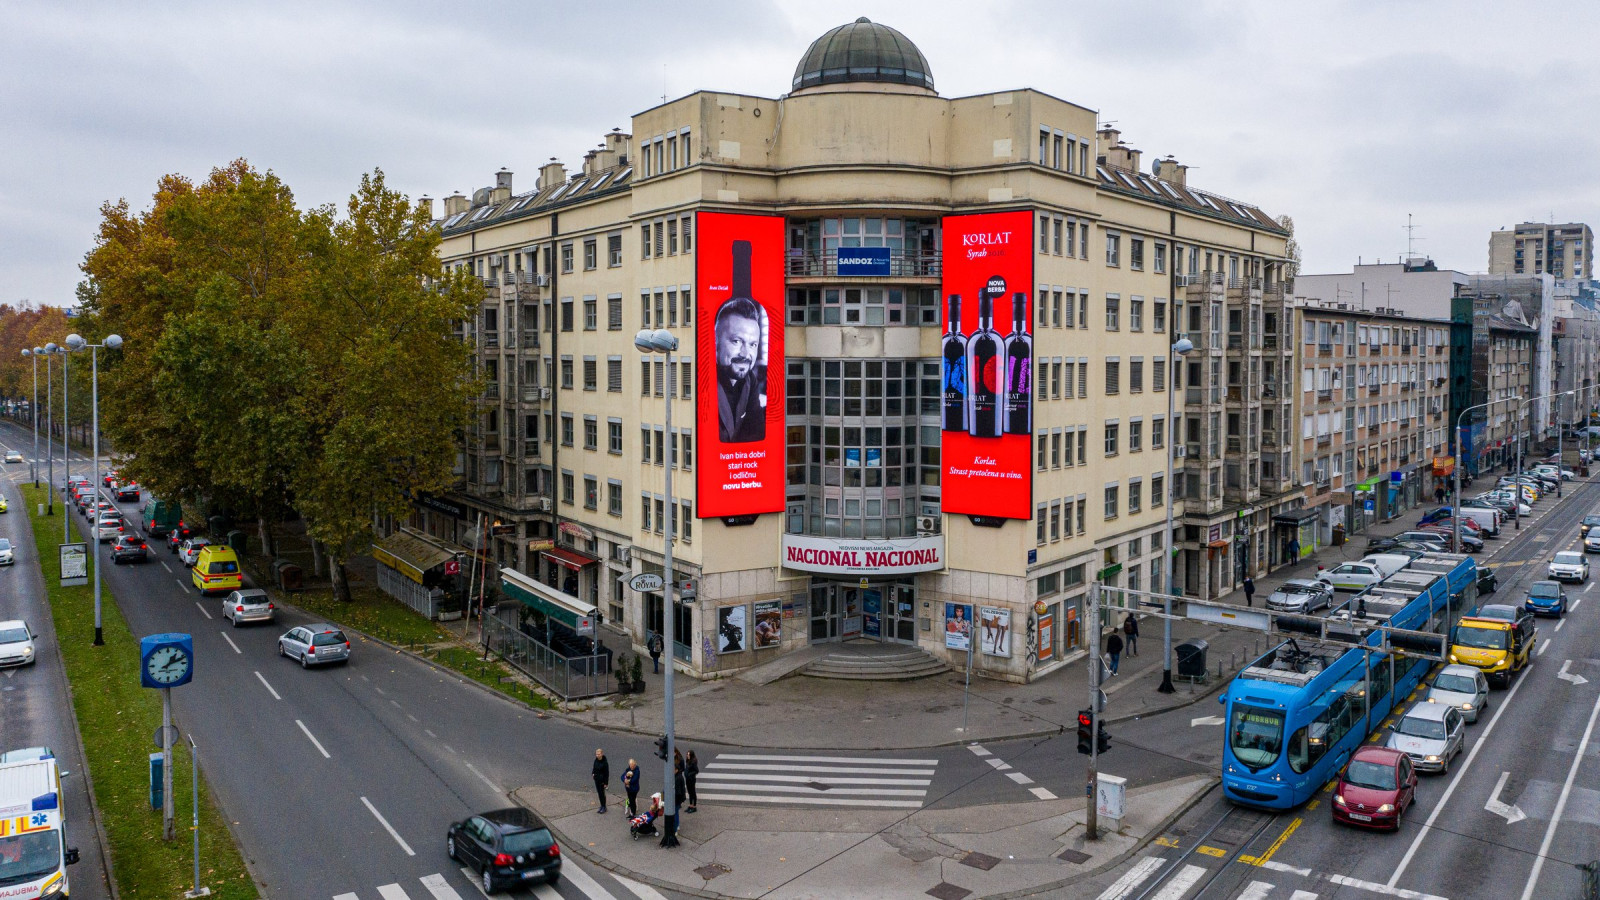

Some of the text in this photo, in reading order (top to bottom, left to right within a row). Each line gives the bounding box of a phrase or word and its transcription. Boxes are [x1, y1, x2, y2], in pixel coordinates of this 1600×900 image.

[962, 231, 1012, 246] KORLAT
[967, 247, 988, 260] Syrah
[838, 257, 873, 265] SANDOZ
[735, 451, 748, 459] bira
[749, 450, 766, 459] dobri
[728, 461, 758, 470] stari rock
[974, 456, 997, 466] Korlat.
[733, 471, 757, 480] odličnu
[949, 466, 970, 475] Strast
[968, 468, 999, 478] pretočena
[1006, 470, 1023, 479] vino.
[741, 480, 763, 489] berbu.
[787, 546, 939, 567] NACIONAL NACIONAL
[635, 581, 658, 590] ROYAL
